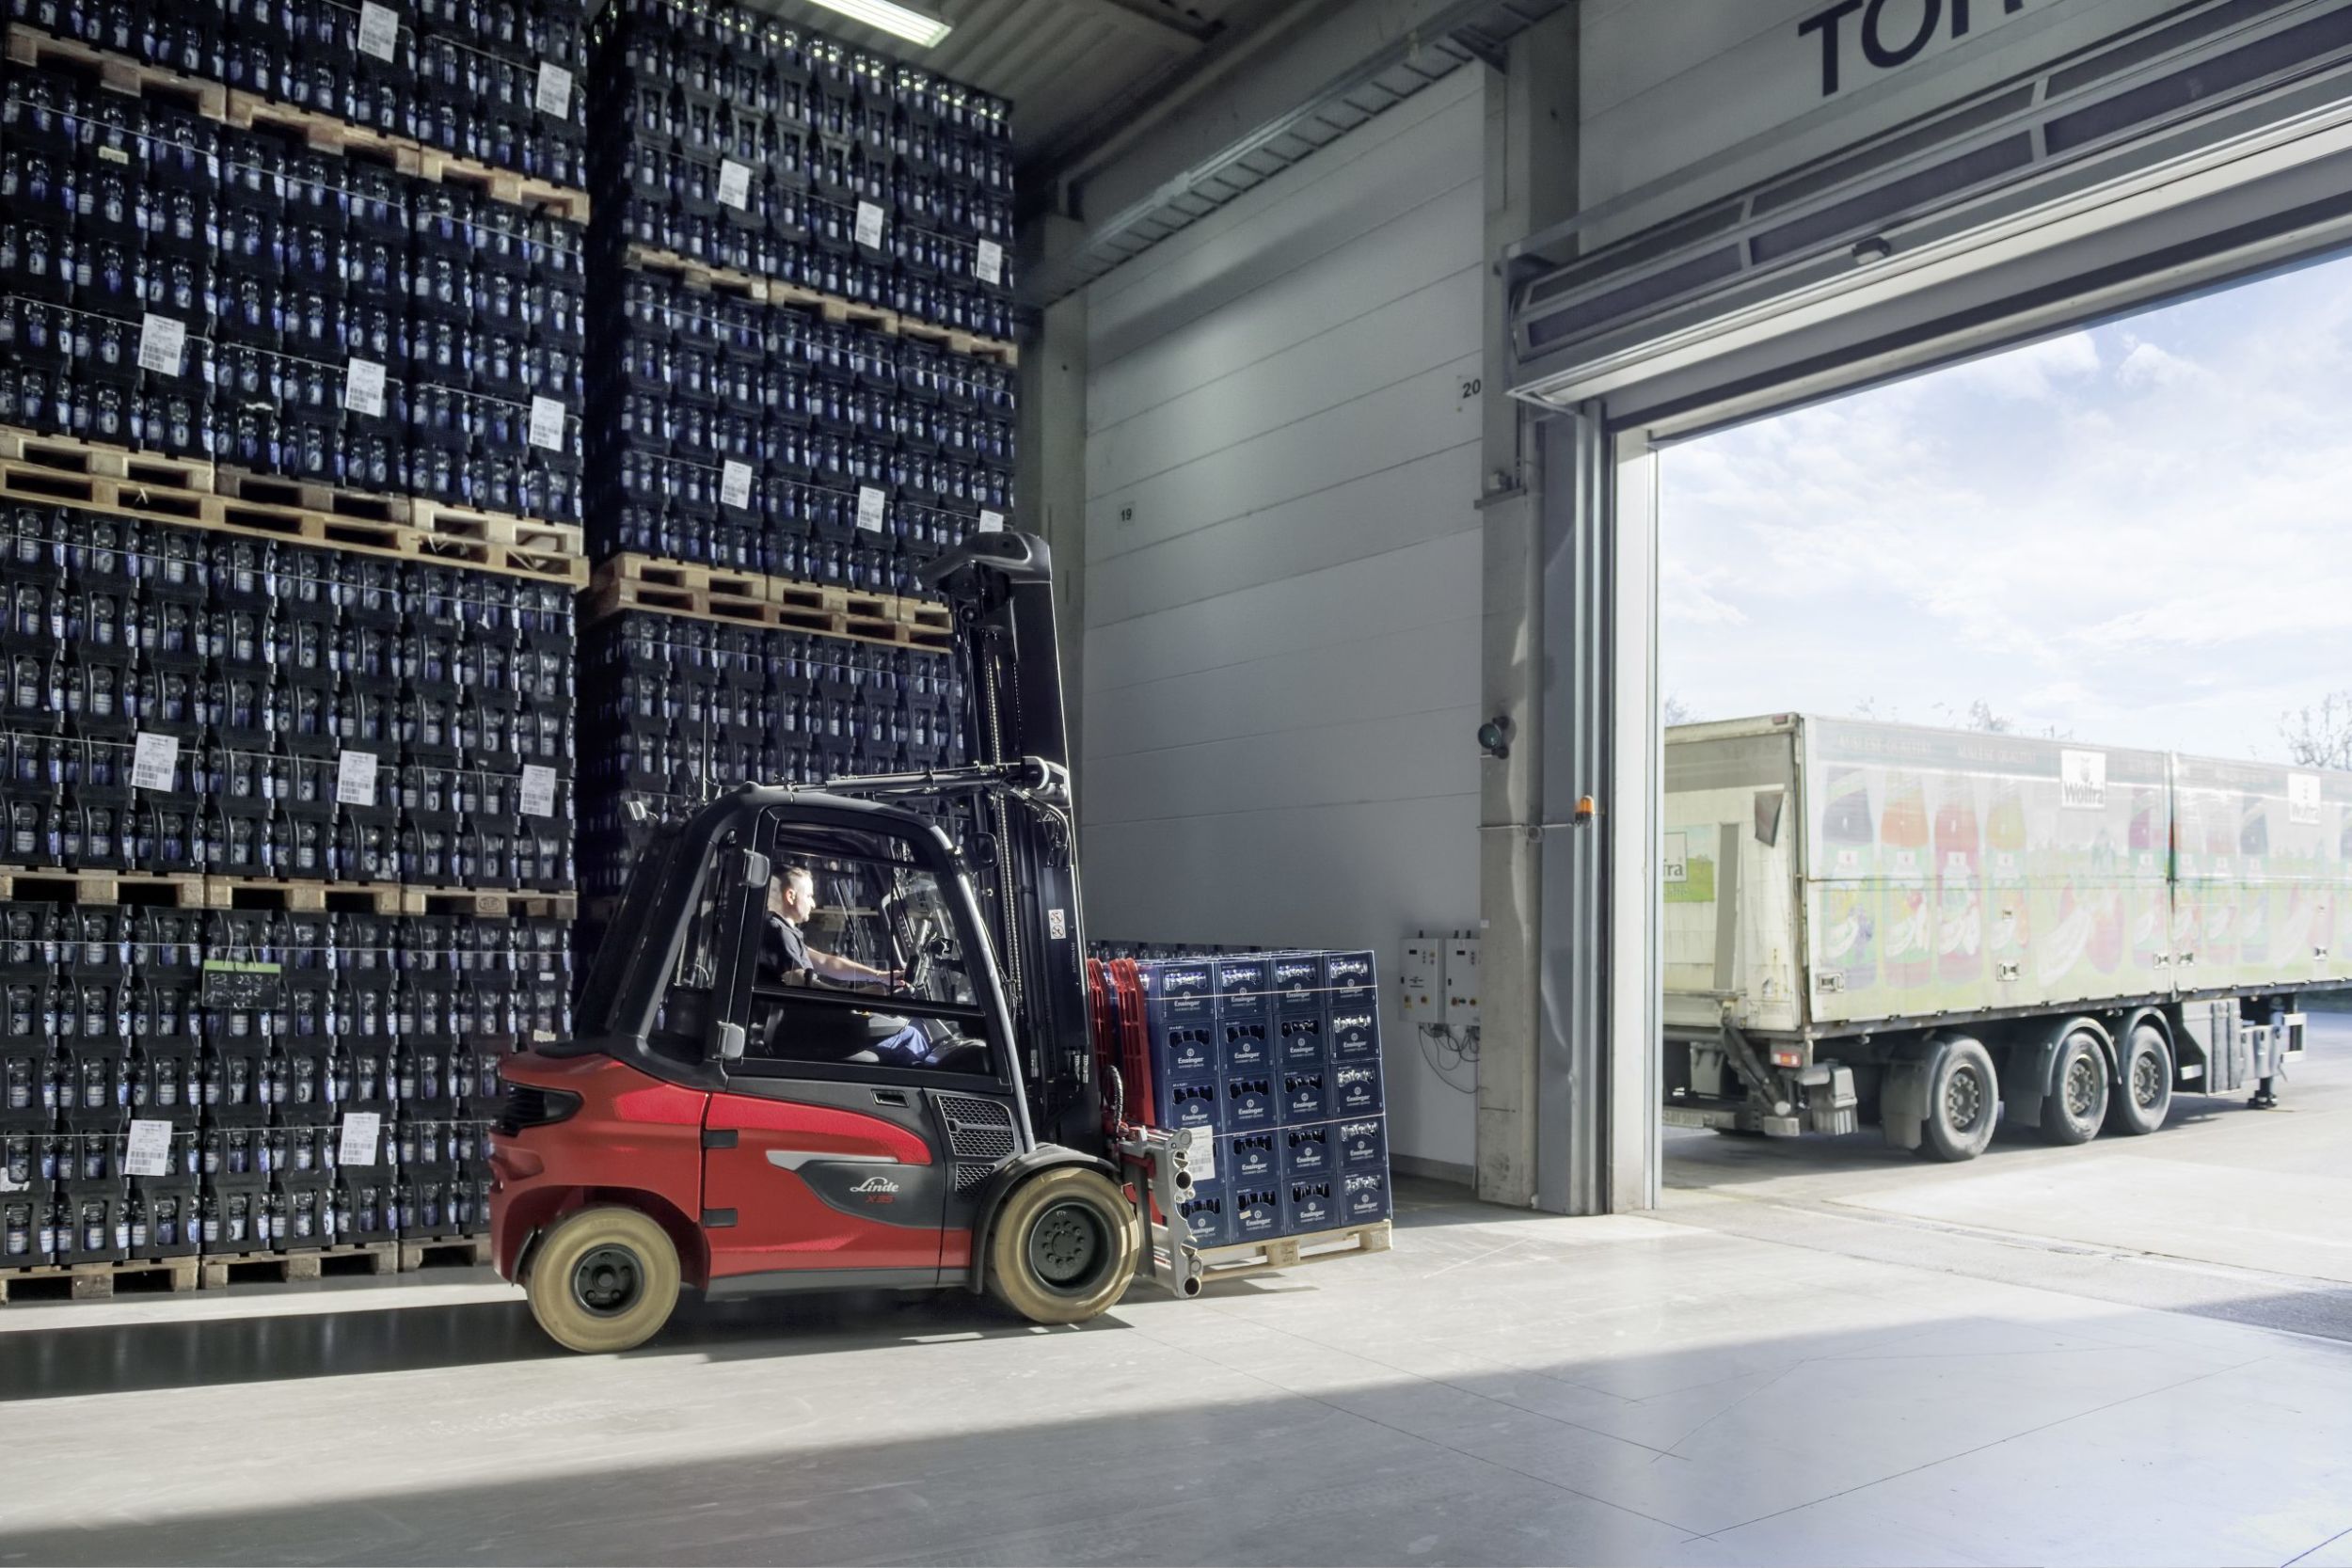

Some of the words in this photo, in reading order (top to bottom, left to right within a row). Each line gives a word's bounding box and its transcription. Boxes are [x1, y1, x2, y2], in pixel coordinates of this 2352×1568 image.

[1462, 378, 1482, 399] 20
[1120, 507, 1133, 522] 19
[2063, 781, 2104, 804] Wolfra
[1178, 1056, 1204, 1065] Ensinger
[1293, 1101, 1317, 1109] Ensinger
[1238, 1106, 1264, 1115] Ensinger
[1182, 1113, 1208, 1121] Ensinger
[1350, 1148, 1375, 1157] Ensinger
[1296, 1155, 1322, 1164] Ensinger
[1242, 1163, 1267, 1171] Ensinger
[850, 1176, 899, 1193] Linde
[1300, 1210, 1325, 1218] Ensinger
[1246, 1217, 1272, 1227] Ensinger
